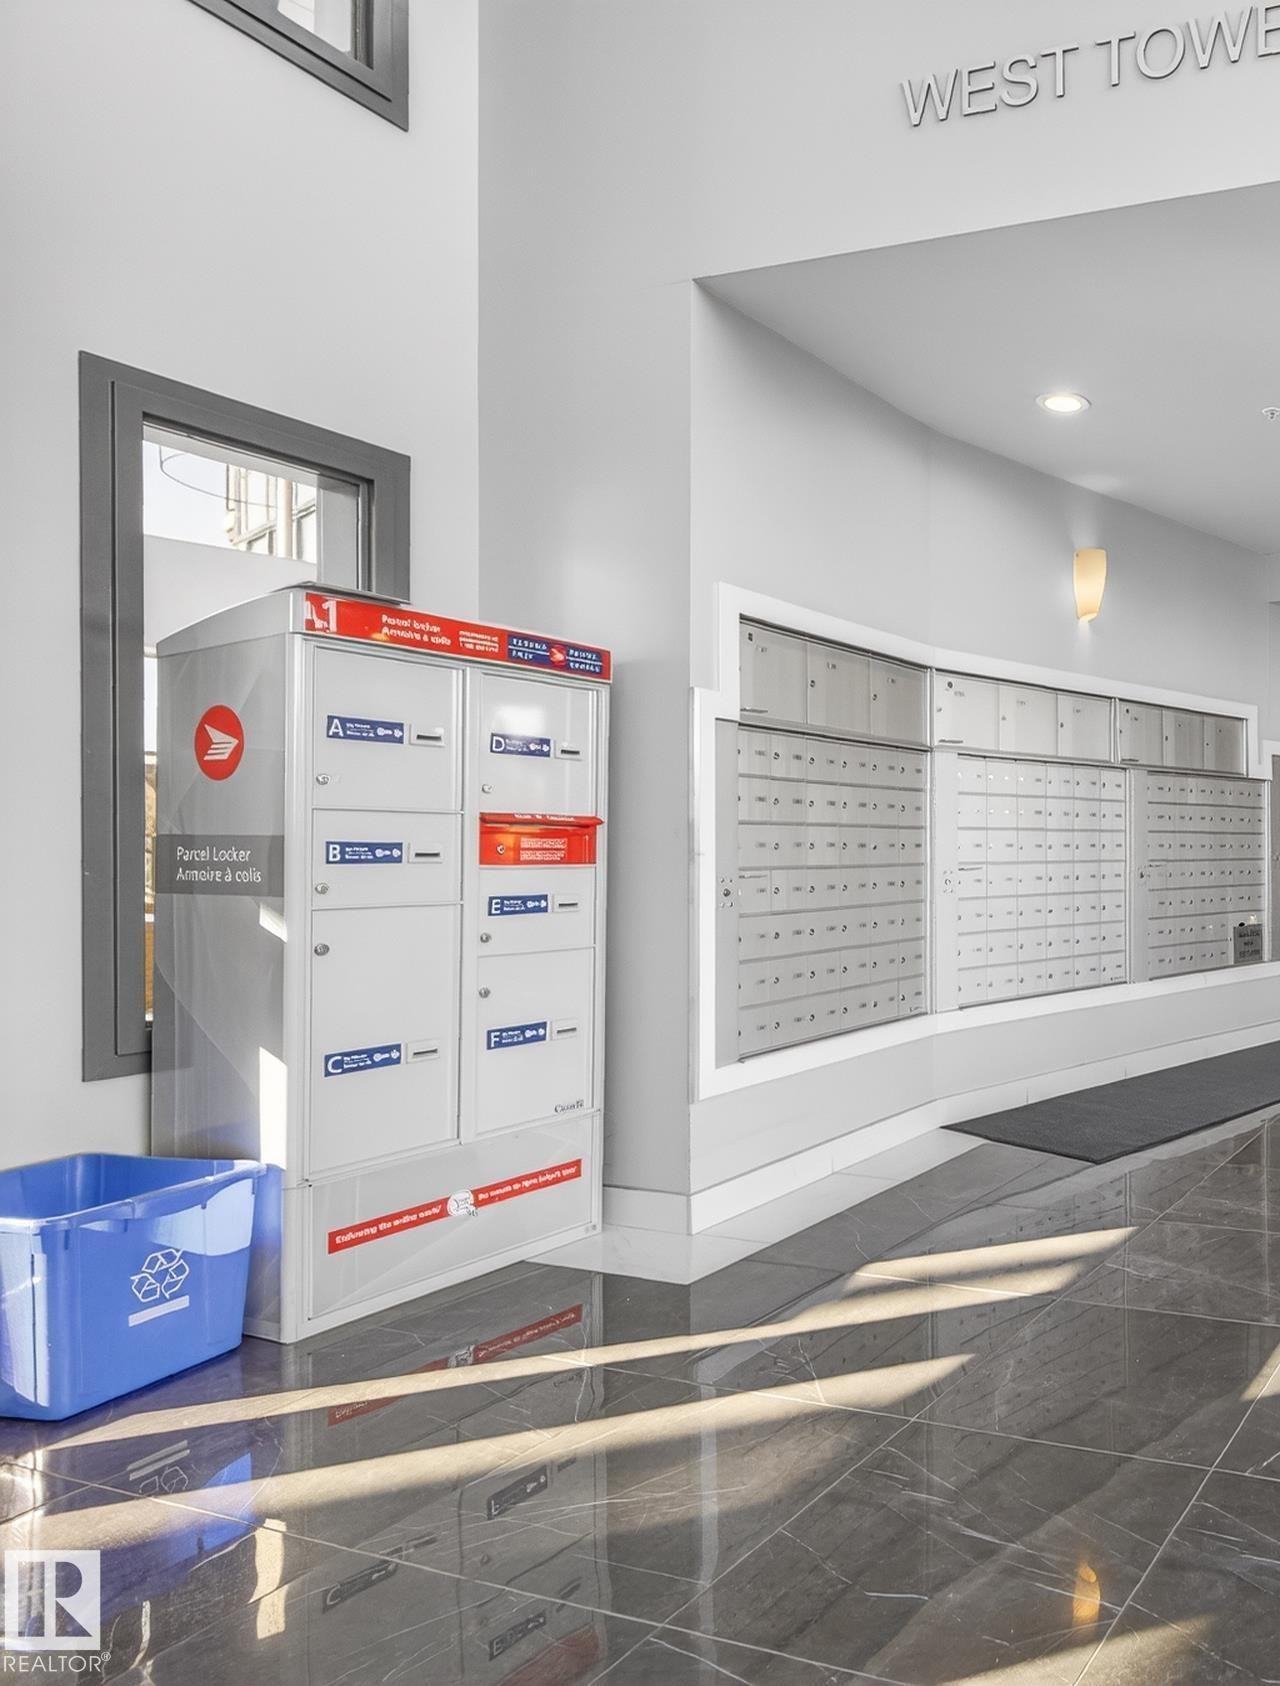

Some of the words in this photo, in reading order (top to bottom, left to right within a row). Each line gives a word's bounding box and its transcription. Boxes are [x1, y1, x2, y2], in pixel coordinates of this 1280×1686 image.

[900, 42, 1080, 127] WEST
[328, 718, 344, 737] A
[492, 735, 505, 751] D
[176, 846, 210, 861] Parcel
[212, 846, 252, 862] Locker
[328, 844, 341, 862] B
[176, 866, 222, 881] Armoire
[224, 866, 232, 882] à
[235, 867, 262, 883] colis
[491, 899, 501, 914] E
[490, 1031, 500, 1048] F
[327, 1055, 343, 1074] C
